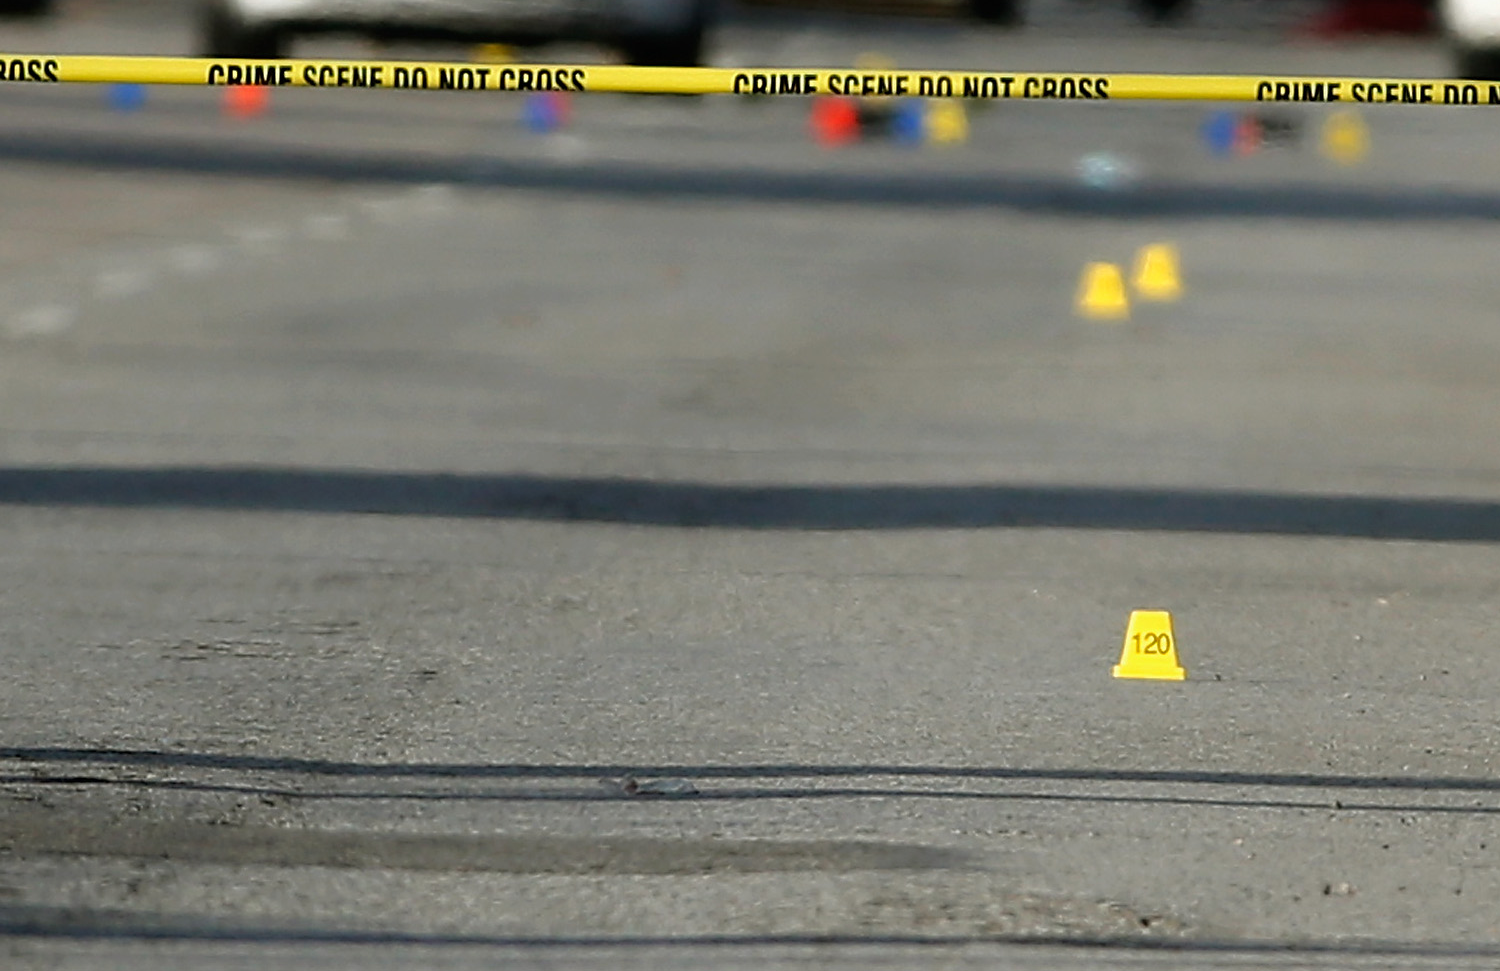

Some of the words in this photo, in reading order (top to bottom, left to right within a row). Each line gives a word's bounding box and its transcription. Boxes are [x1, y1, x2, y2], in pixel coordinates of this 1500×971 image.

[0, 59, 58, 82] OSS
[208, 64, 292, 86] CRIME
[303, 66, 383, 88] SCENE
[394, 67, 428, 89] DO
[439, 68, 490, 90] NOT
[499, 69, 585, 92] CROSS
[733, 73, 817, 95] CRIME
[828, 75, 908, 96] SCENE
[919, 76, 953, 97] DO
[963, 76, 1015, 98] NOT
[1023, 78, 1108, 100] CROSS
[1257, 82, 1341, 102] CRIME
[1351, 83, 1433, 103] SCENE
[1443, 84, 1478, 105] DO
[1131, 632, 1171, 655] 120
